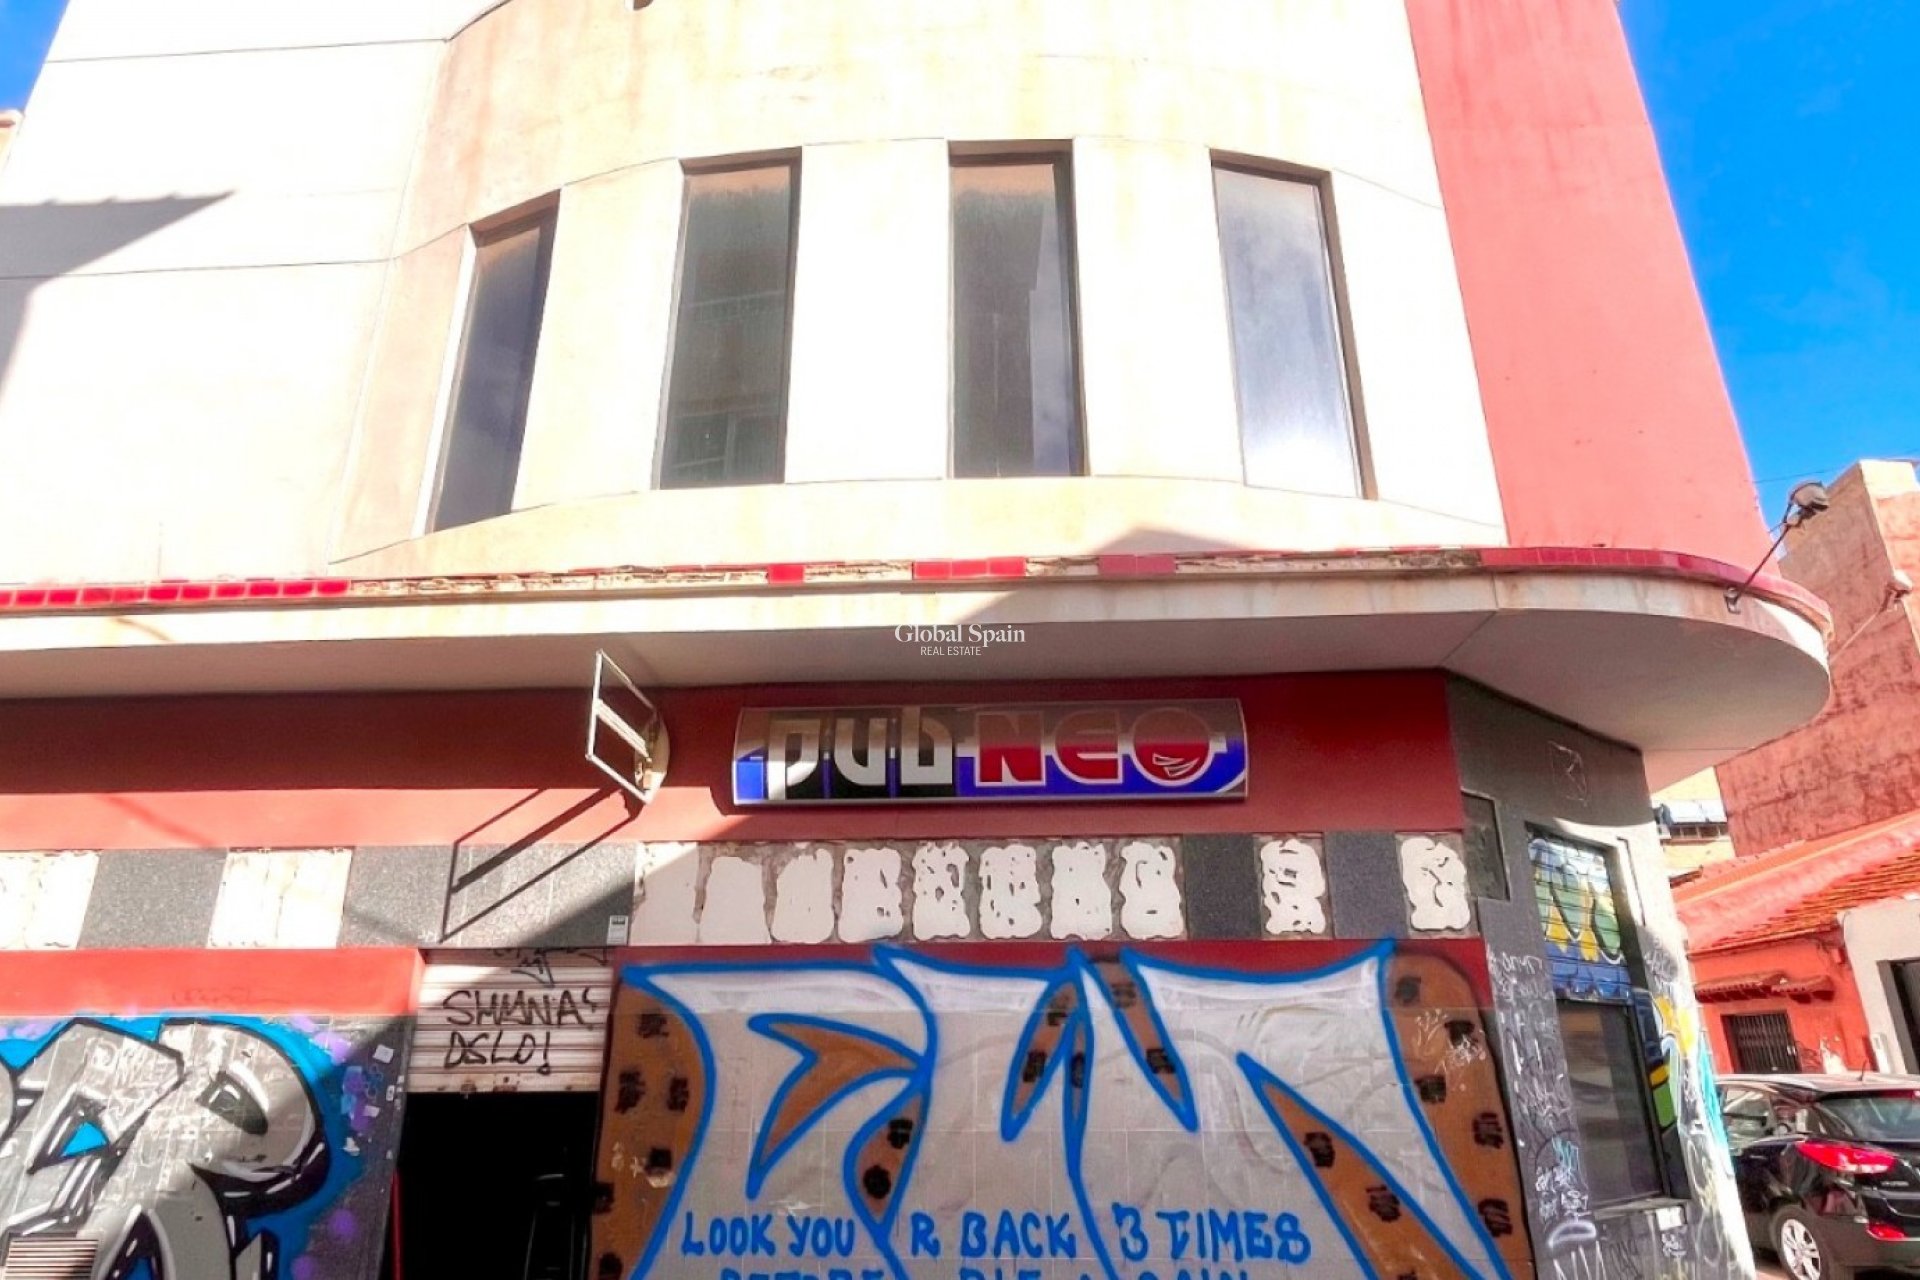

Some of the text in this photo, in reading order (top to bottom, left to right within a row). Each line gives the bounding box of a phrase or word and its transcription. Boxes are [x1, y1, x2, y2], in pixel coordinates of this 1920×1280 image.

[681, 1211, 777, 1257] LOOK
[787, 1213, 856, 1257] YOU
[911, 1211, 941, 1257] R
[960, 1208, 1077, 1259] BACK
[1155, 1207, 1312, 1264] TIMES
